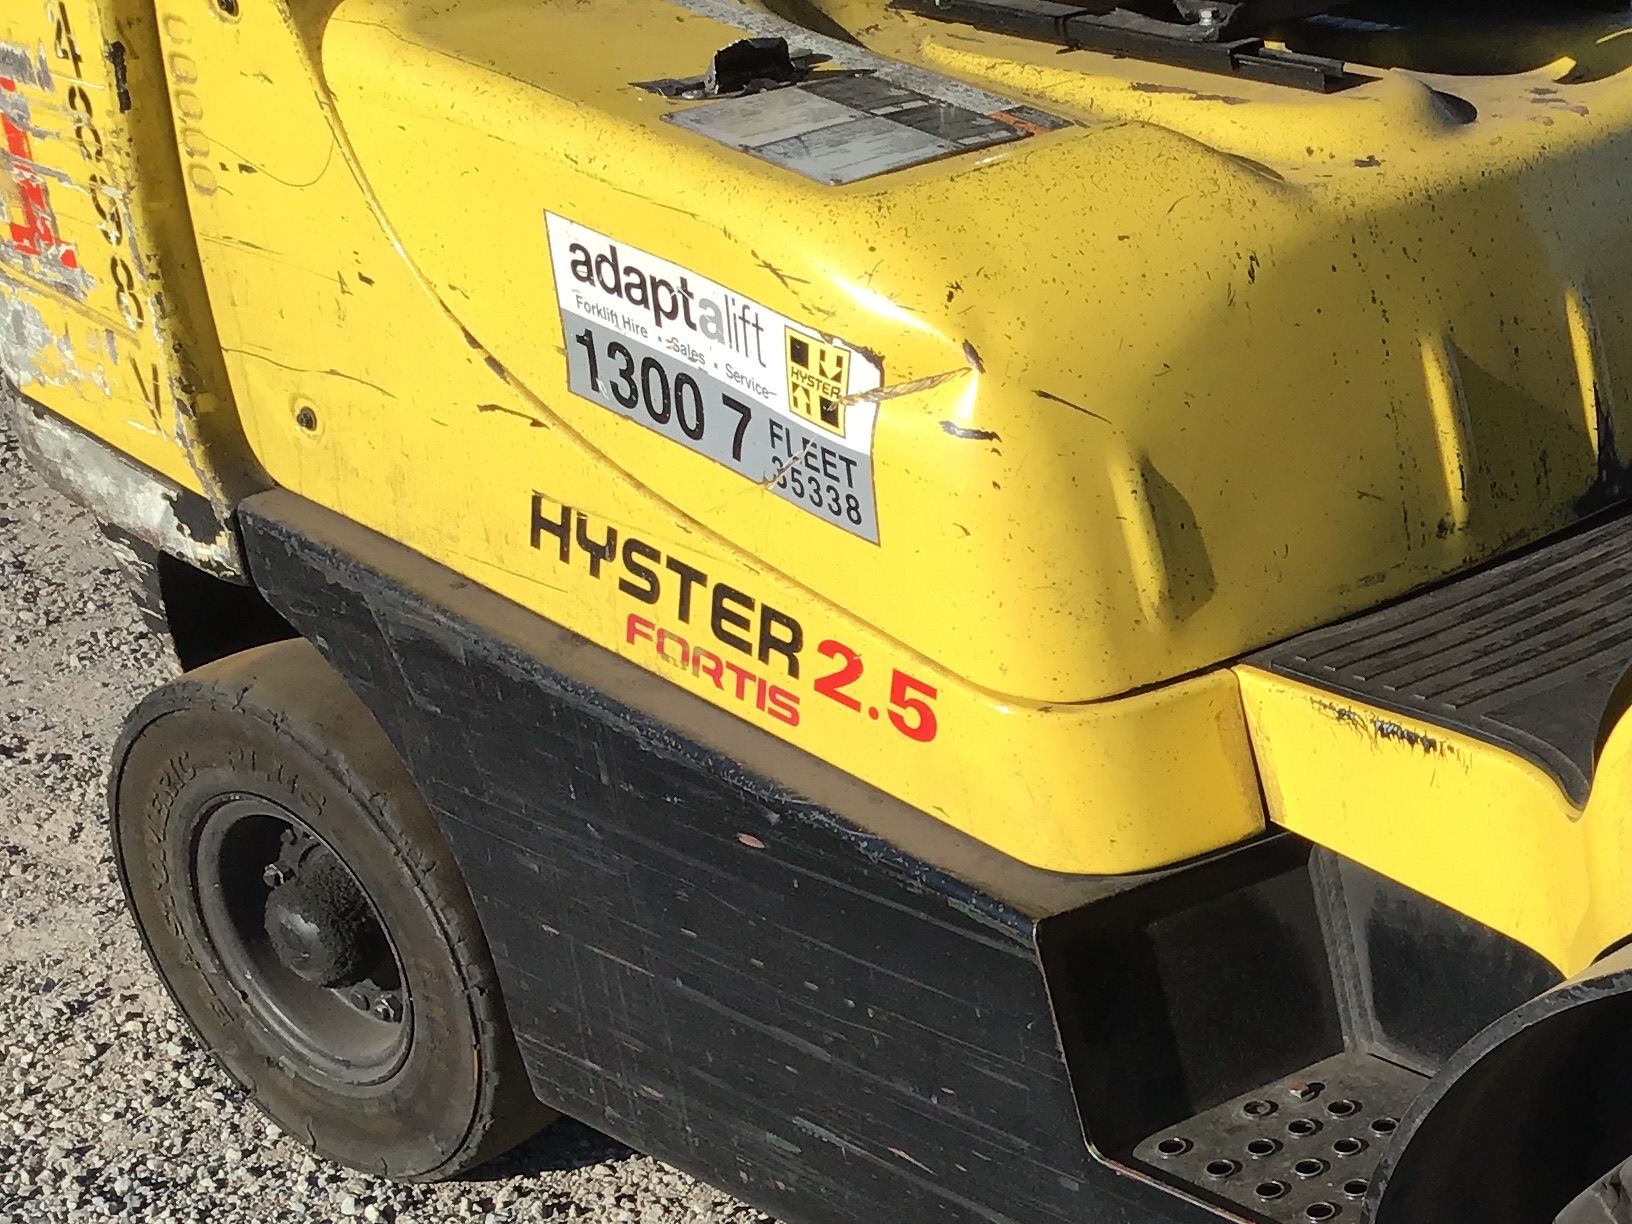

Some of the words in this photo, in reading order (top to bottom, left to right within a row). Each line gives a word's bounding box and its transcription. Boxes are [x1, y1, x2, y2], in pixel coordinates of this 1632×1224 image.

[569, 243, 767, 368] adaptalift
[575, 295, 619, 327] Forklift
[622, 315, 649, 339] Hire
[671, 337, 706, 365] Sales
[725, 363, 769, 399] Service
[575, 328, 705, 441] 1300
[721, 398, 753, 462] 7
[769, 418, 858, 489] FLEET
[790, 366, 842, 400] HYSTER
[771, 455, 863, 526] 35338
[530, 490, 804, 680] HYSTER
[813, 639, 938, 743] 2.5
[626, 612, 800, 728] FORTIS
